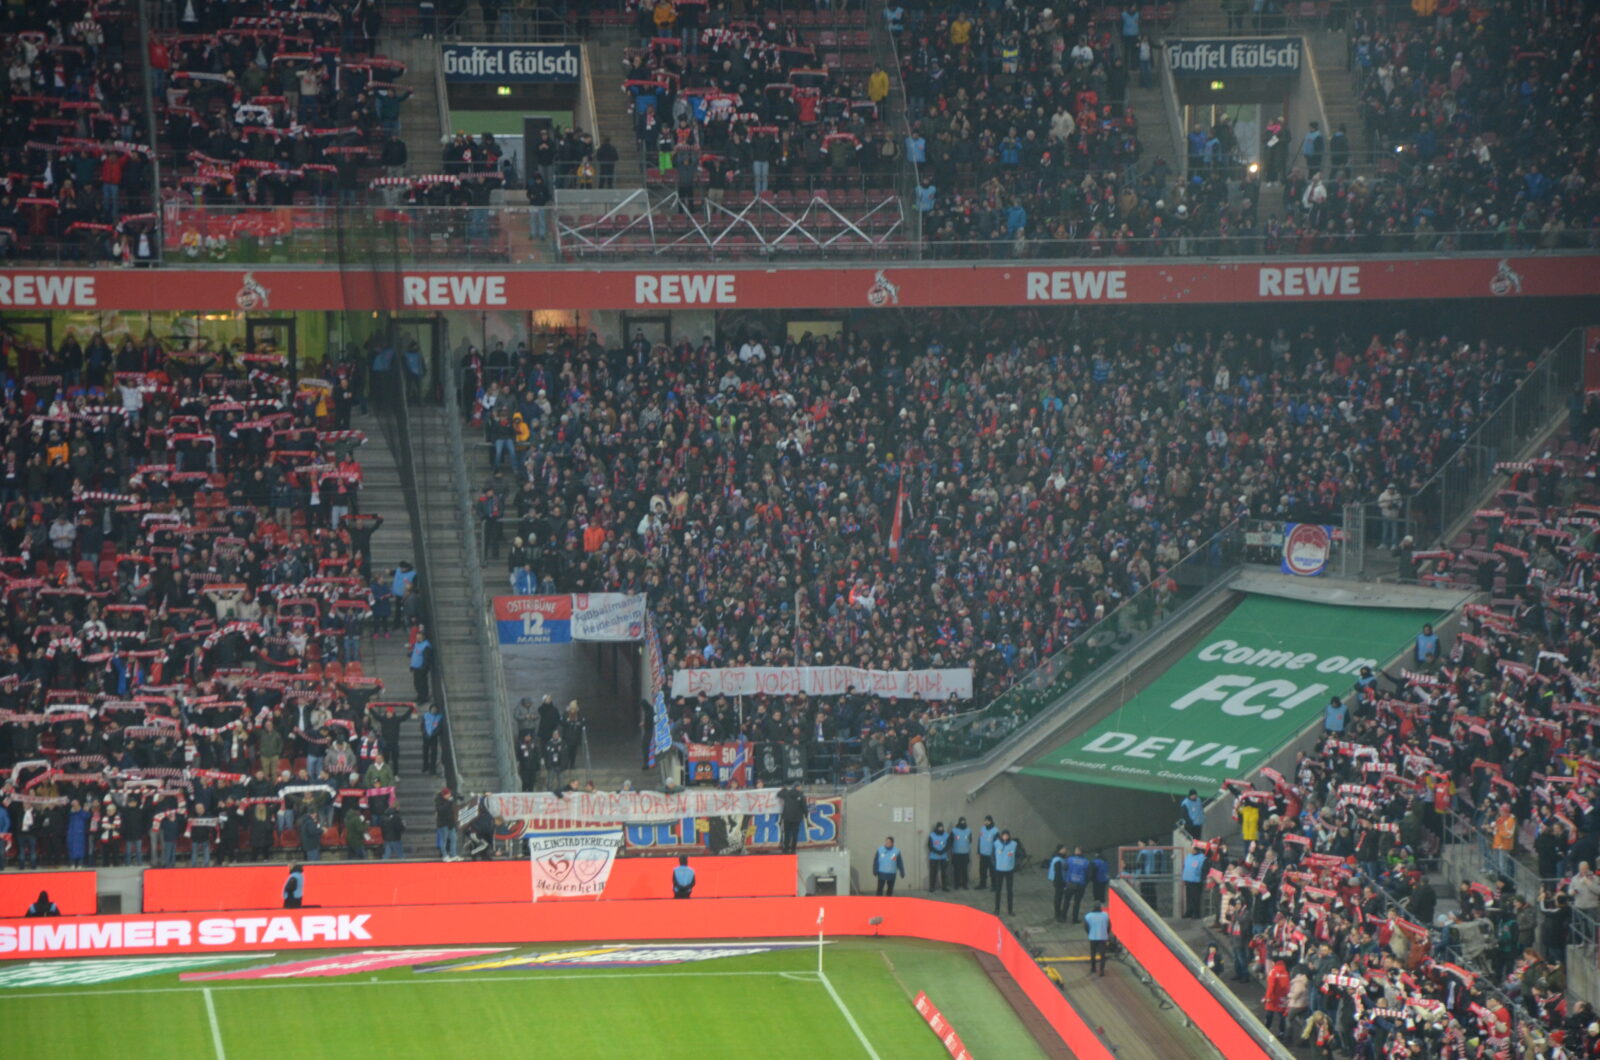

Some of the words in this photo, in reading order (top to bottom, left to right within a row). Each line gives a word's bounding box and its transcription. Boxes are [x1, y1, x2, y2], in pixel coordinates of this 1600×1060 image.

[443, 47, 505, 76] Gaffel
[509, 48, 579, 76] Kölsch
[1167, 43, 1227, 71] Gaffel
[1231, 43, 1299, 70] Kölsch
[0, 276, 97, 306] REWE
[403, 276, 507, 305] REWE
[635, 275, 737, 303] REWE
[1027, 271, 1127, 300] REWE
[1259, 266, 1361, 296] REWE
[1198, 639, 1318, 670] Come
[1316, 655, 1378, 676] on
[688, 669, 712, 693] ES
[755, 668, 802, 693] NOCH
[1170, 674, 1330, 720] FC!
[1081, 731, 1261, 770] DEVK
[198, 914, 373, 946] STARK
